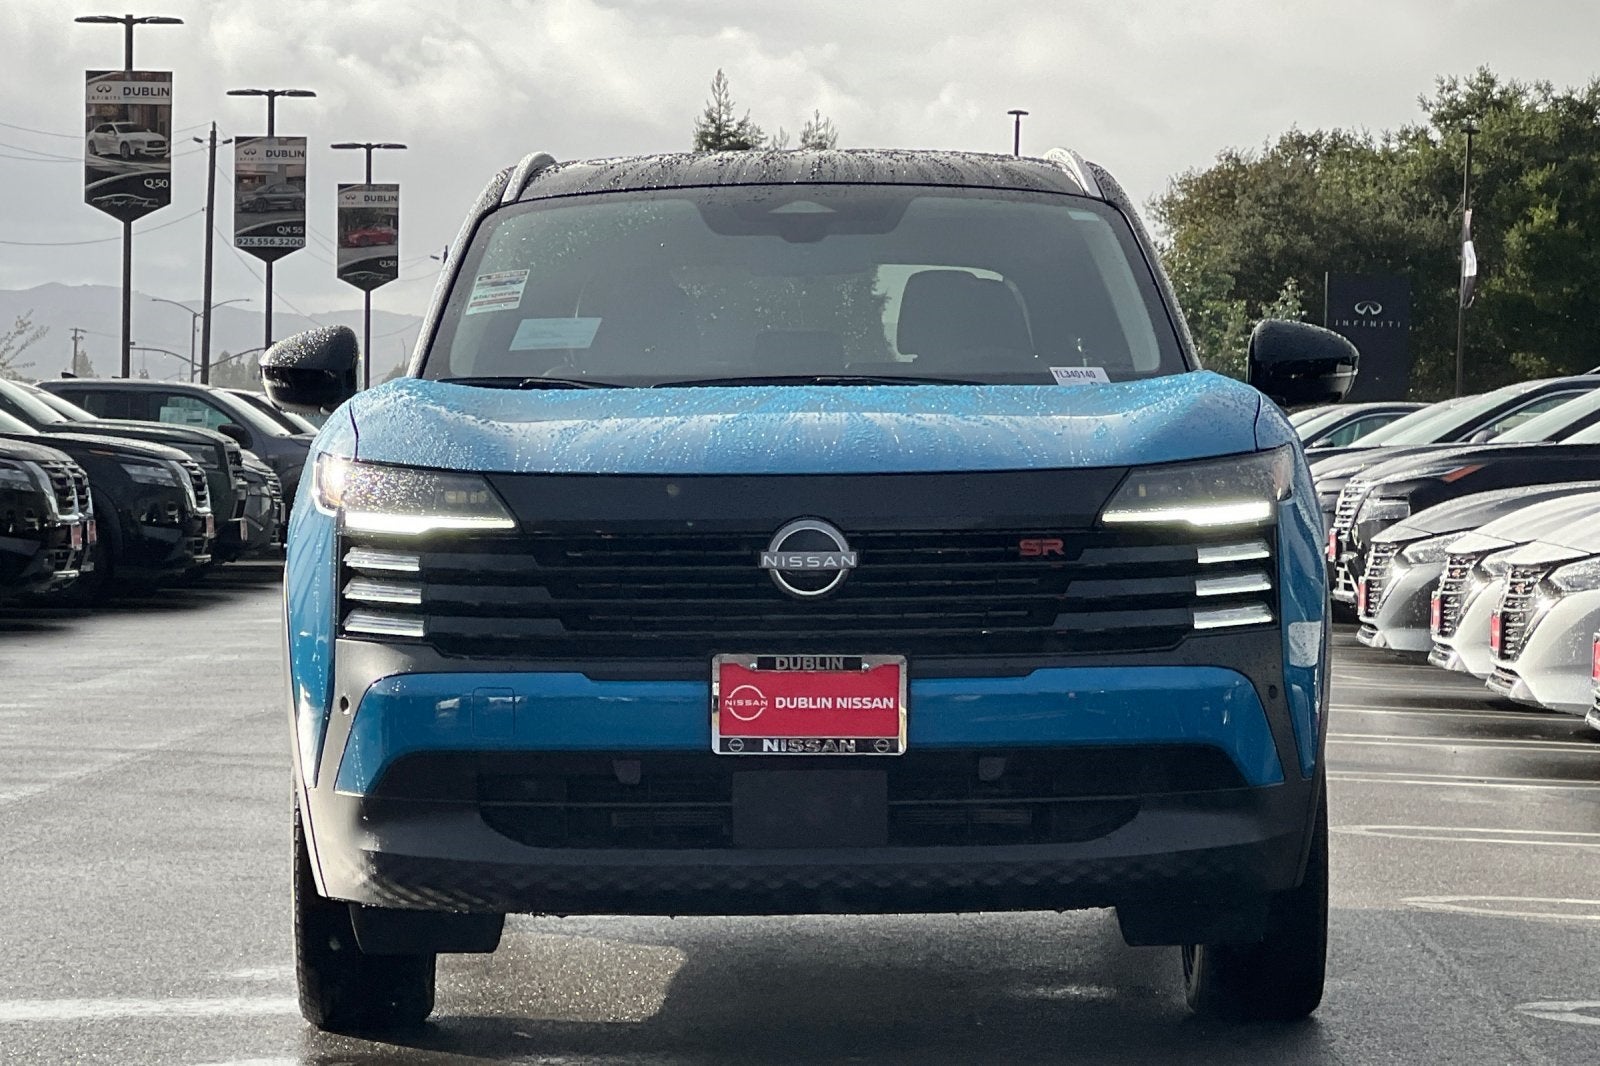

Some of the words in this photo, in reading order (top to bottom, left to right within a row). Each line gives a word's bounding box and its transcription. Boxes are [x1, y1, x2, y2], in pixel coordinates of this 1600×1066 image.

[123, 86, 170, 97] DUBLIN
[265, 149, 305, 158] DUBLIN
[144, 178, 169, 189] Q50
[364, 194, 398, 202] DUBLIN
[236, 237, 304, 246] 925.556.3200
[1335, 319, 1401, 328] INFINITI
[1053, 370, 1097, 379] TL340140
[1018, 538, 1065, 556] SR
[763, 554, 856, 568] NISSAN
[775, 656, 844, 671] DUBLIN
[725, 699, 768, 707] NISSAN
[775, 697, 833, 709] DUBLIN
[836, 697, 894, 709] NISSAN
[762, 738, 856, 753] NISSAN
